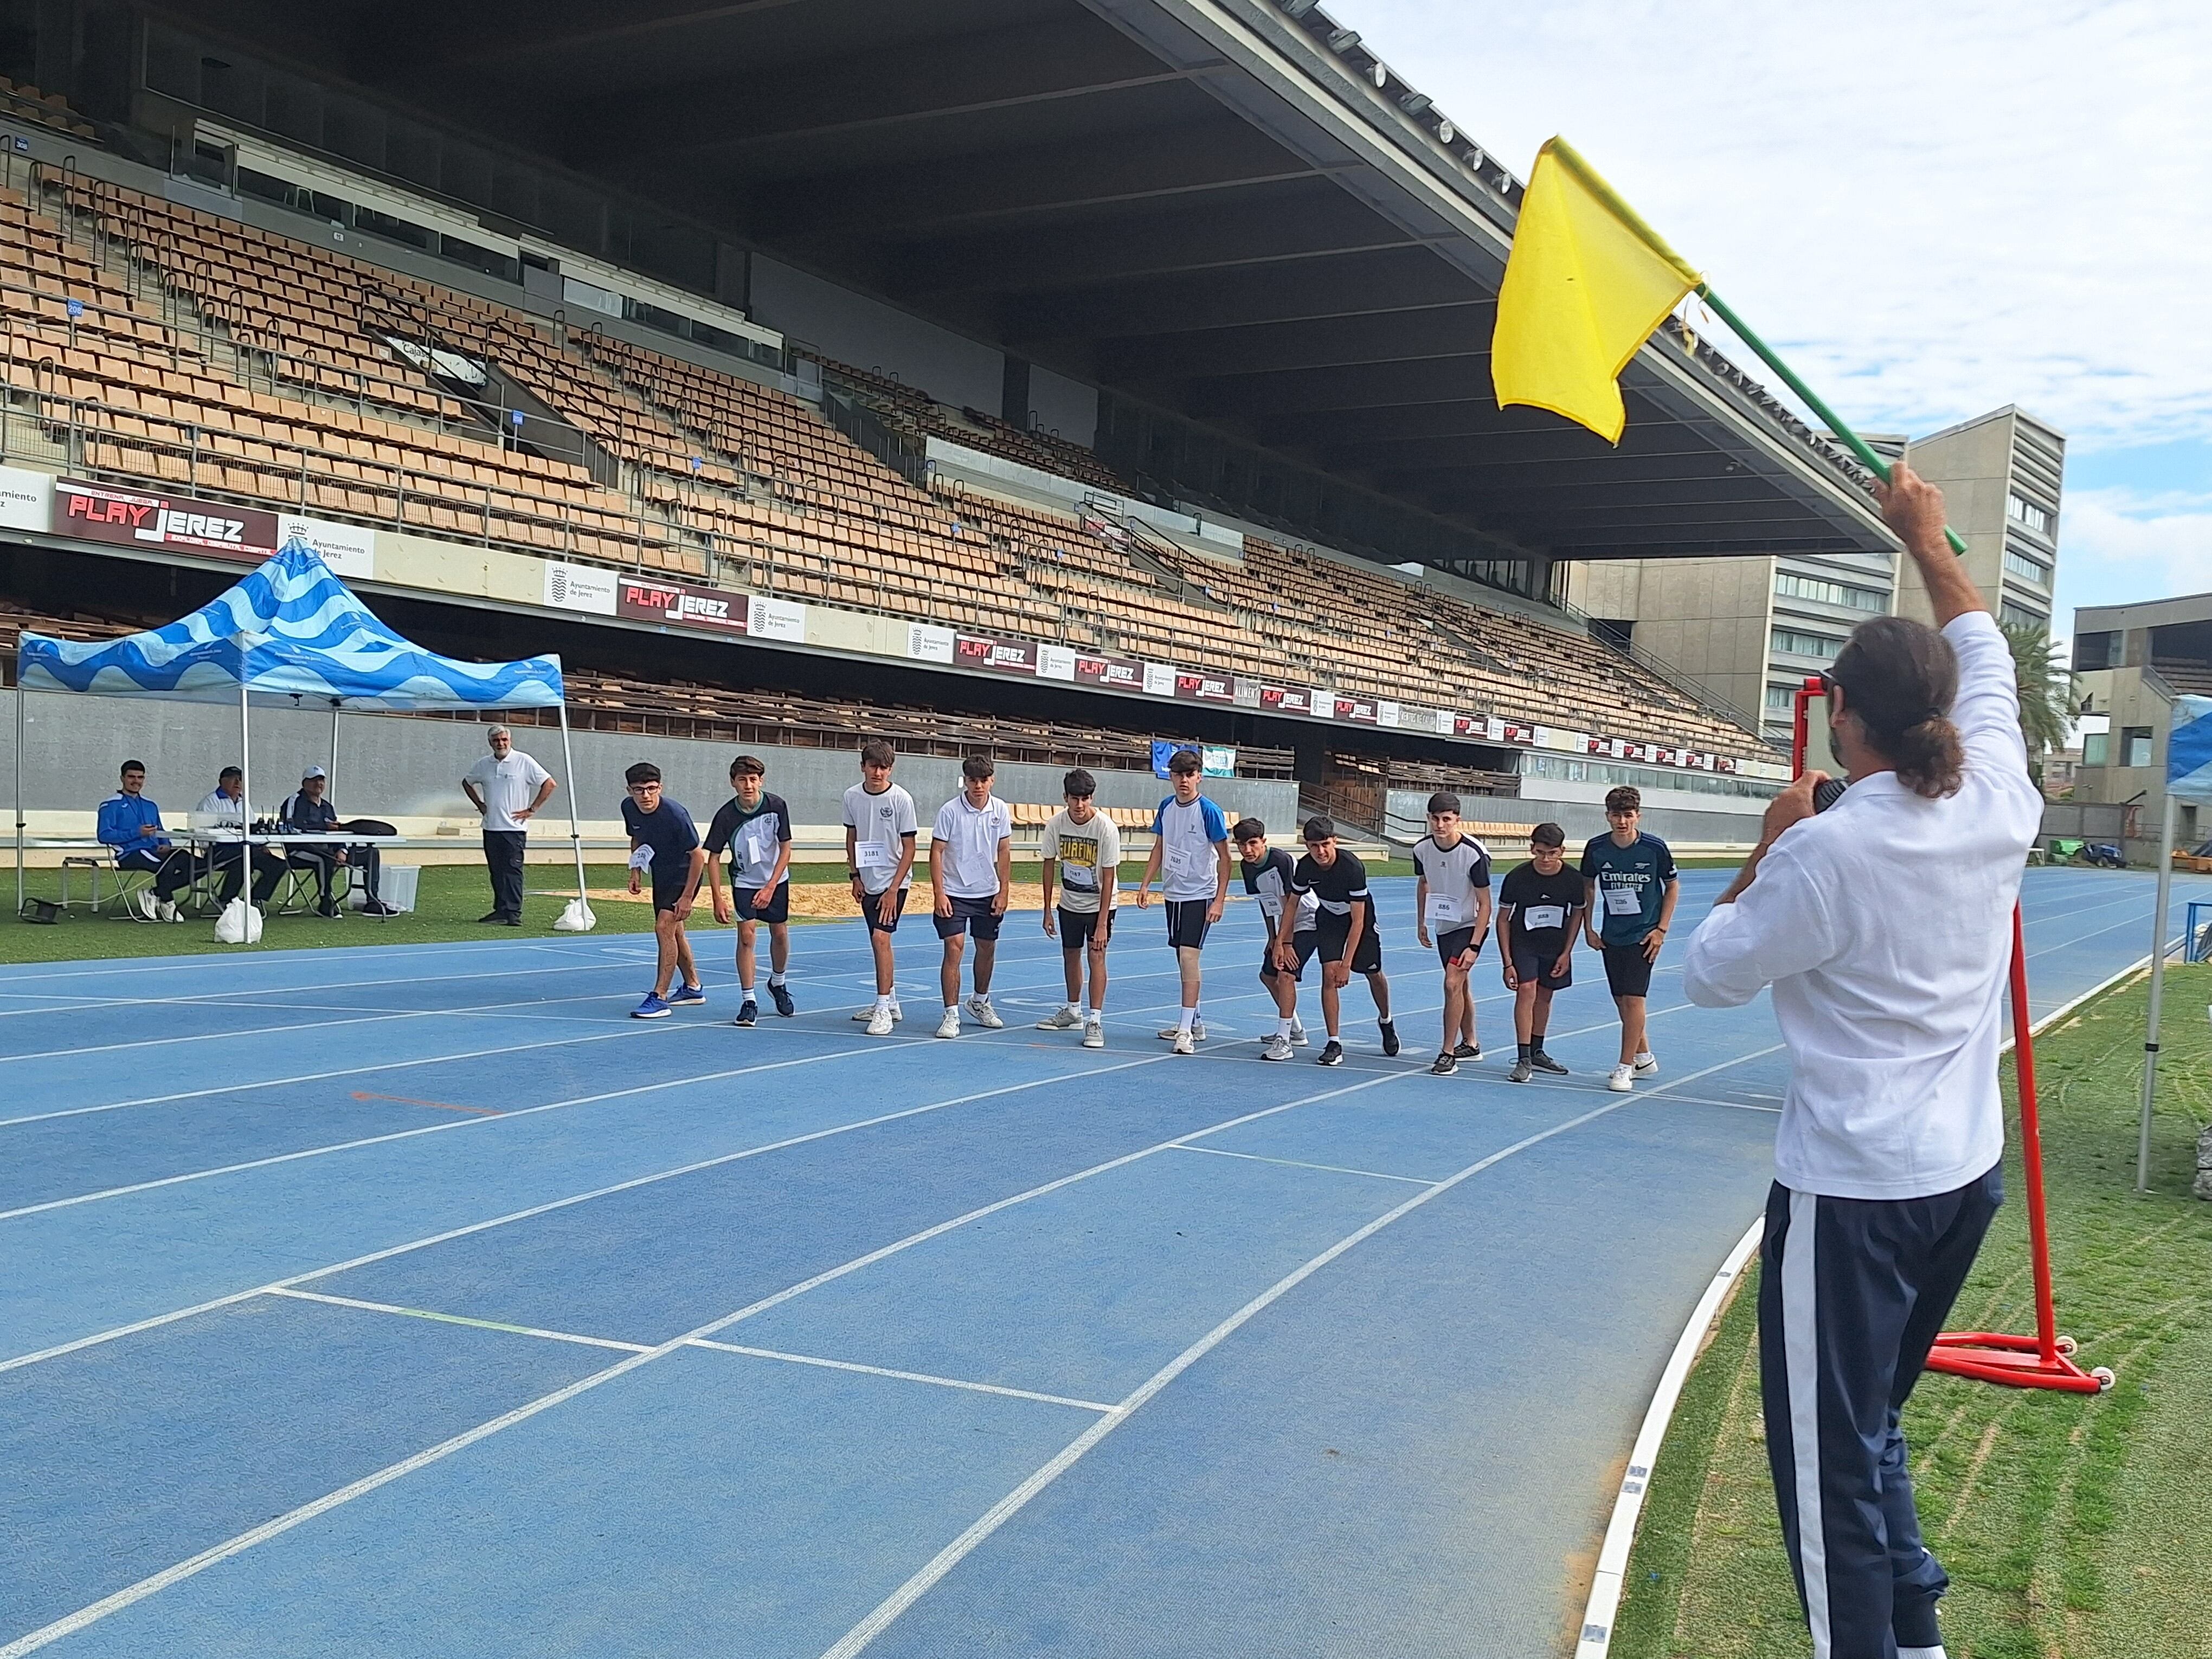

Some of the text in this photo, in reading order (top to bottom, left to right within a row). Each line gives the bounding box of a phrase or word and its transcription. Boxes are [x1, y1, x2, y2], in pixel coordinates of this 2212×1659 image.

[68, 305, 82, 314] 208
[0, 490, 37, 503] miento
[68, 494, 152, 526] PLAY
[312, 539, 365, 554] Ayuntamiento
[323, 550, 342, 560] Jerez
[570, 581, 610, 593] Ayuntamiento
[578, 590, 593, 598] Jerez
[626, 587, 676, 609] PLAY
[959, 641, 991, 657] PLAY
[1078, 660, 1106, 675] PLAY
[1178, 677, 1201, 690] PLAY
[1263, 690, 1283, 702] PLAY
[1601, 871, 1651, 883] Emirates
